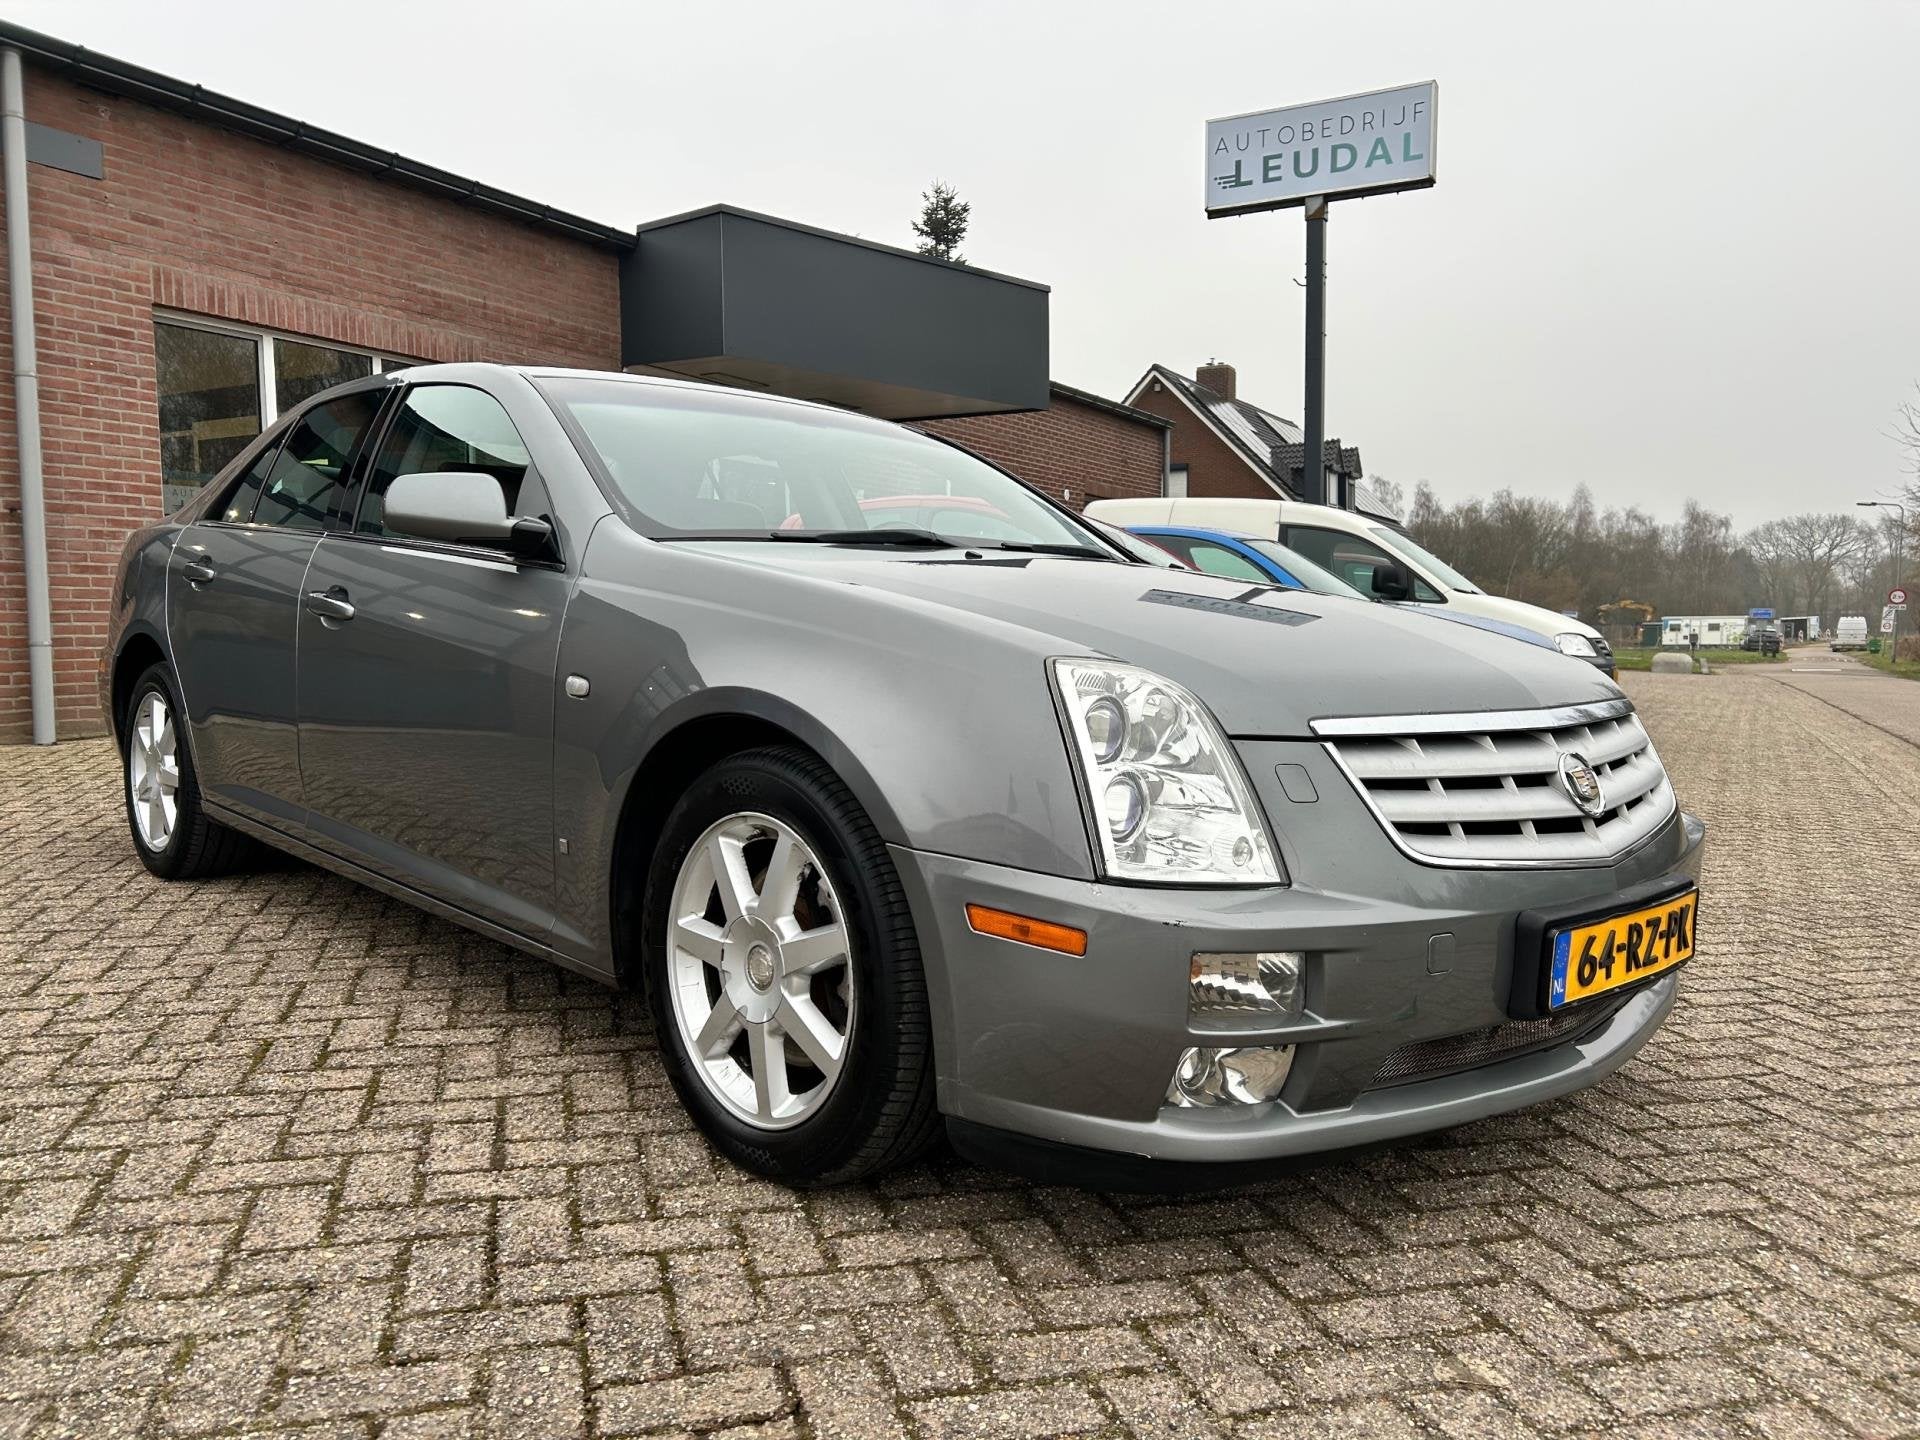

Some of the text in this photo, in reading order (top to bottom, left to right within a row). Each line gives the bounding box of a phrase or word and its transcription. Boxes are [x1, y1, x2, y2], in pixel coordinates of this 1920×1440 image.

[1214, 101, 1425, 155] AUTOBEDRIJF
[1229, 131, 1424, 188] LEUDAL
[1577, 903, 1691, 987] 64-RZ-PK
[1553, 978, 1564, 996] NL
